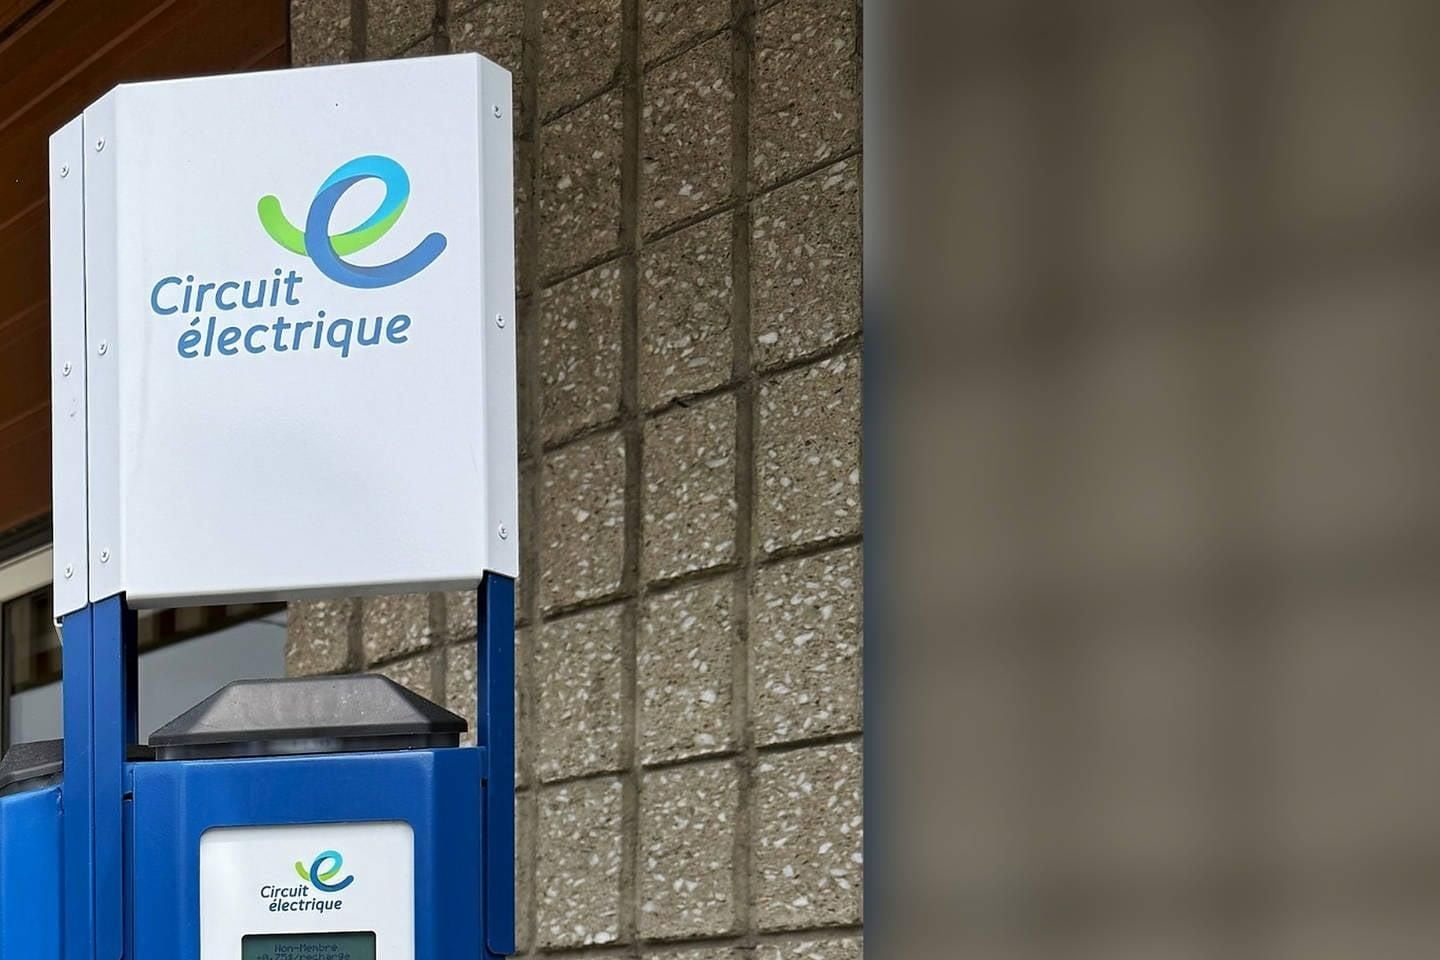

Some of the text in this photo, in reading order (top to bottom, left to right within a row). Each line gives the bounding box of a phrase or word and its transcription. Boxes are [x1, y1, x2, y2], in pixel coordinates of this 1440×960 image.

[150, 268, 303, 315] Circuit
[176, 310, 411, 358] électrique
[260, 884, 309, 898] Circuit
[269, 898, 343, 913] électrique
